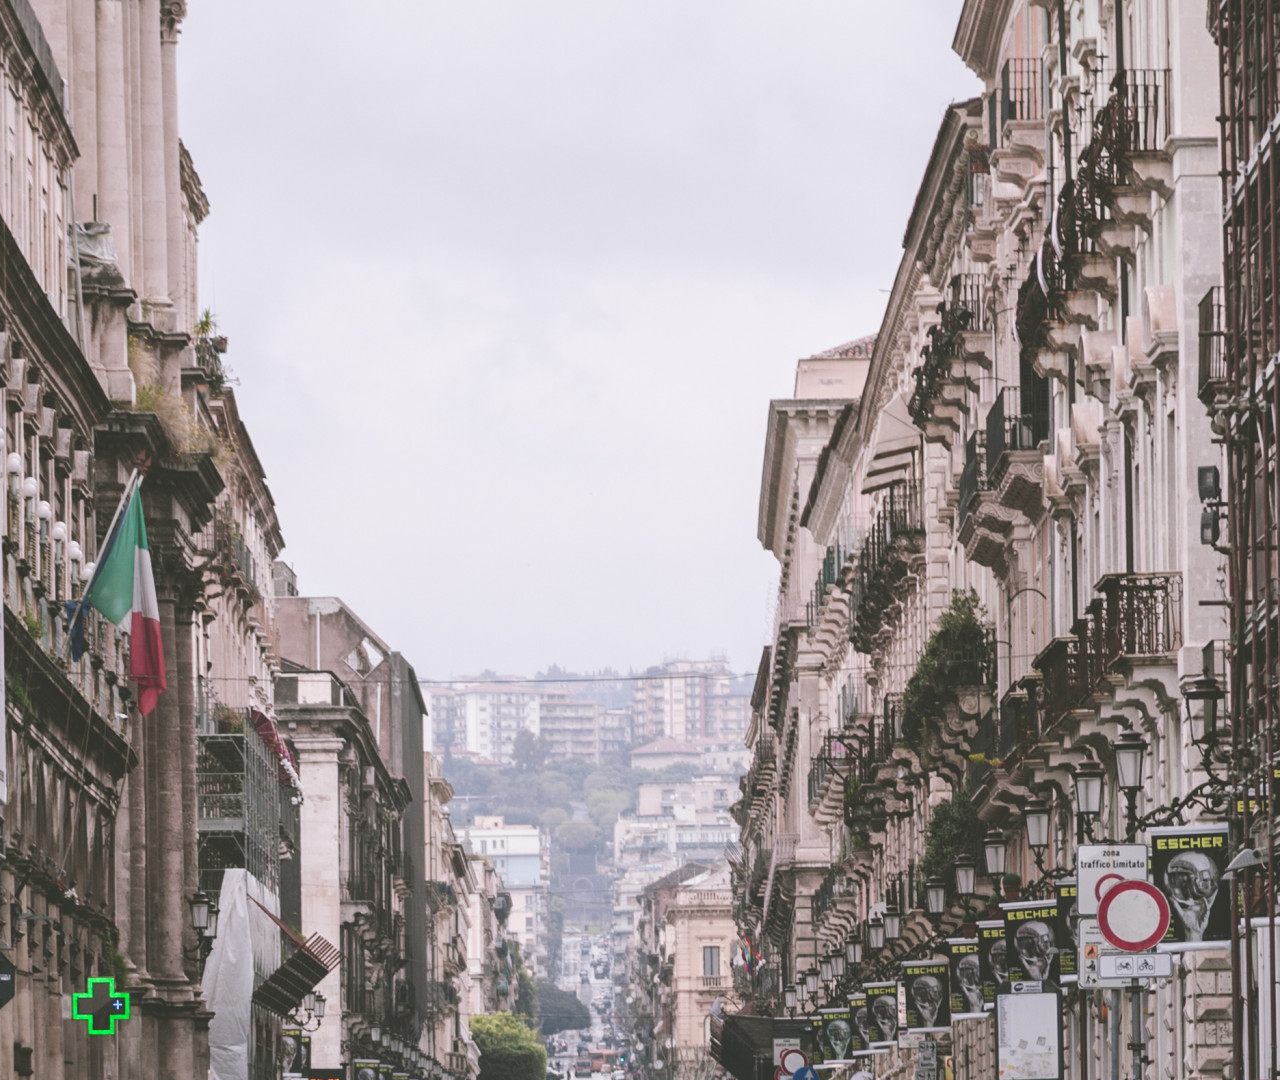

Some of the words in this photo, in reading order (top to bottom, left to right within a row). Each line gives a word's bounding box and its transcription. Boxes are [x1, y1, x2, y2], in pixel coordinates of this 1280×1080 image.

[1157, 836, 1224, 850] ESCHER
[1081, 860, 1111, 869] traffico
[1113, 859, 1145, 869] limitato
[1007, 908, 1058, 921] ESCHER
[907, 966, 946, 975] ESCHER
